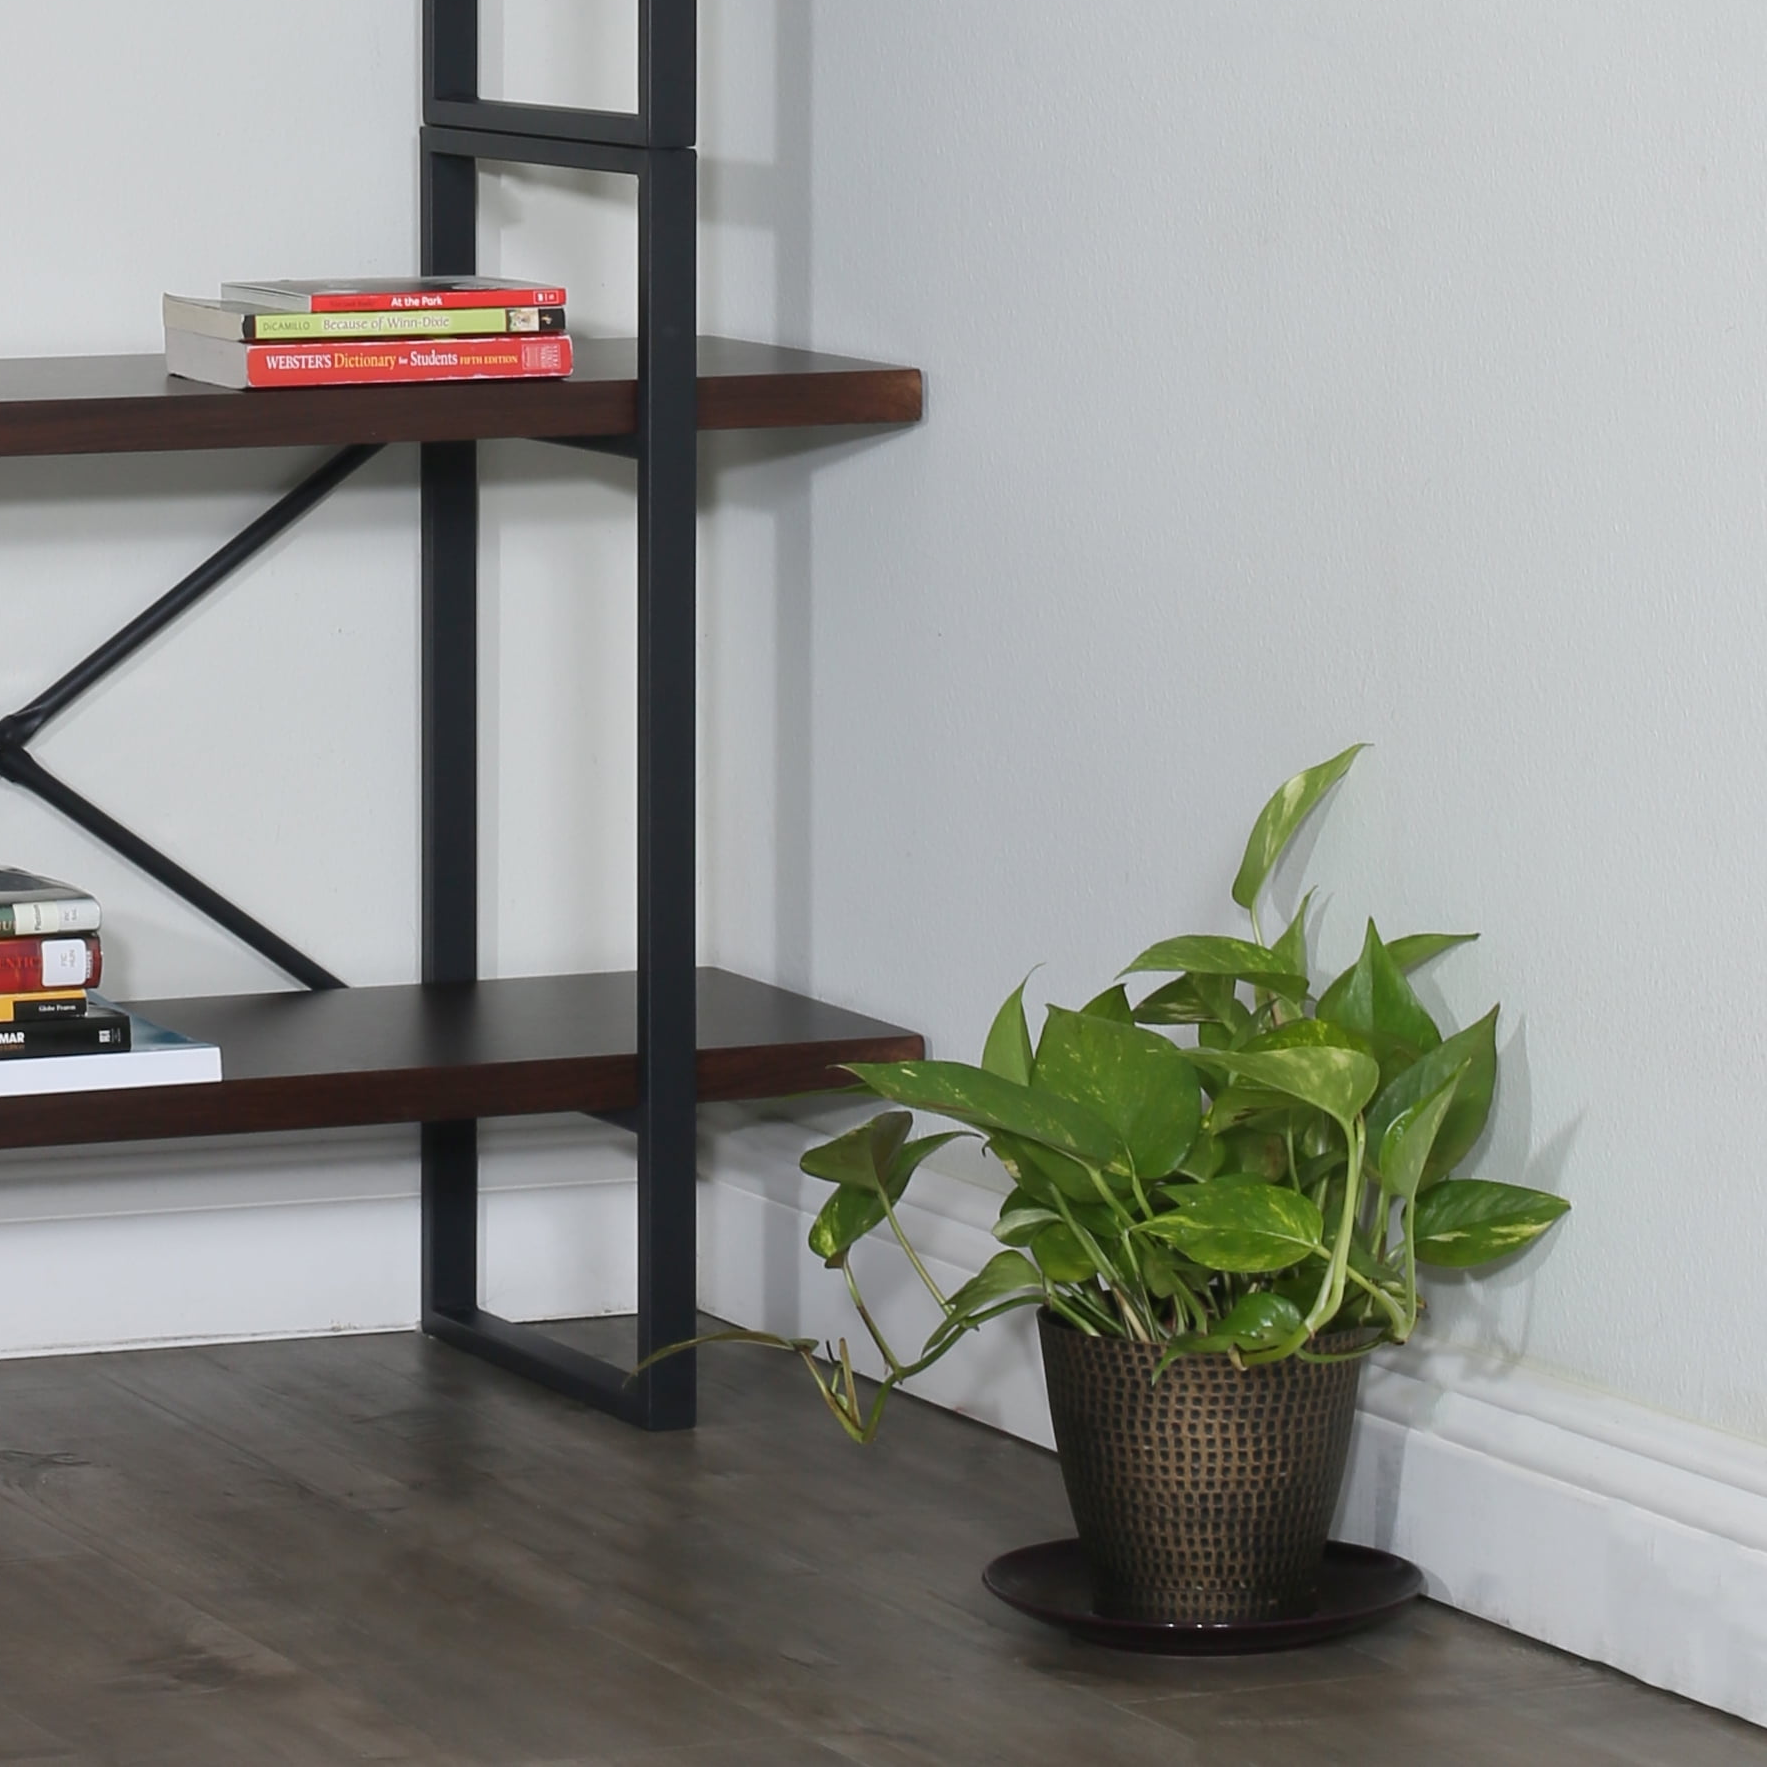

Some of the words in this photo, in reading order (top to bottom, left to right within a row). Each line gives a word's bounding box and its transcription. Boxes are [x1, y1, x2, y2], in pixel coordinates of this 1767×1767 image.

[391, 296, 403, 307] At
[404, 296, 420, 307] the
[421, 295, 443, 306] Park
[323, 318, 368, 331] Because
[371, 317, 384, 332] of
[387, 315, 449, 329] Winn-Dixie
[266, 354, 332, 370] WEBSTER'S
[334, 352, 396, 370] Dictionary
[410, 350, 458, 366] Students
[459, 355, 483, 365] FIFTH
[483, 354, 518, 365] EDITION
